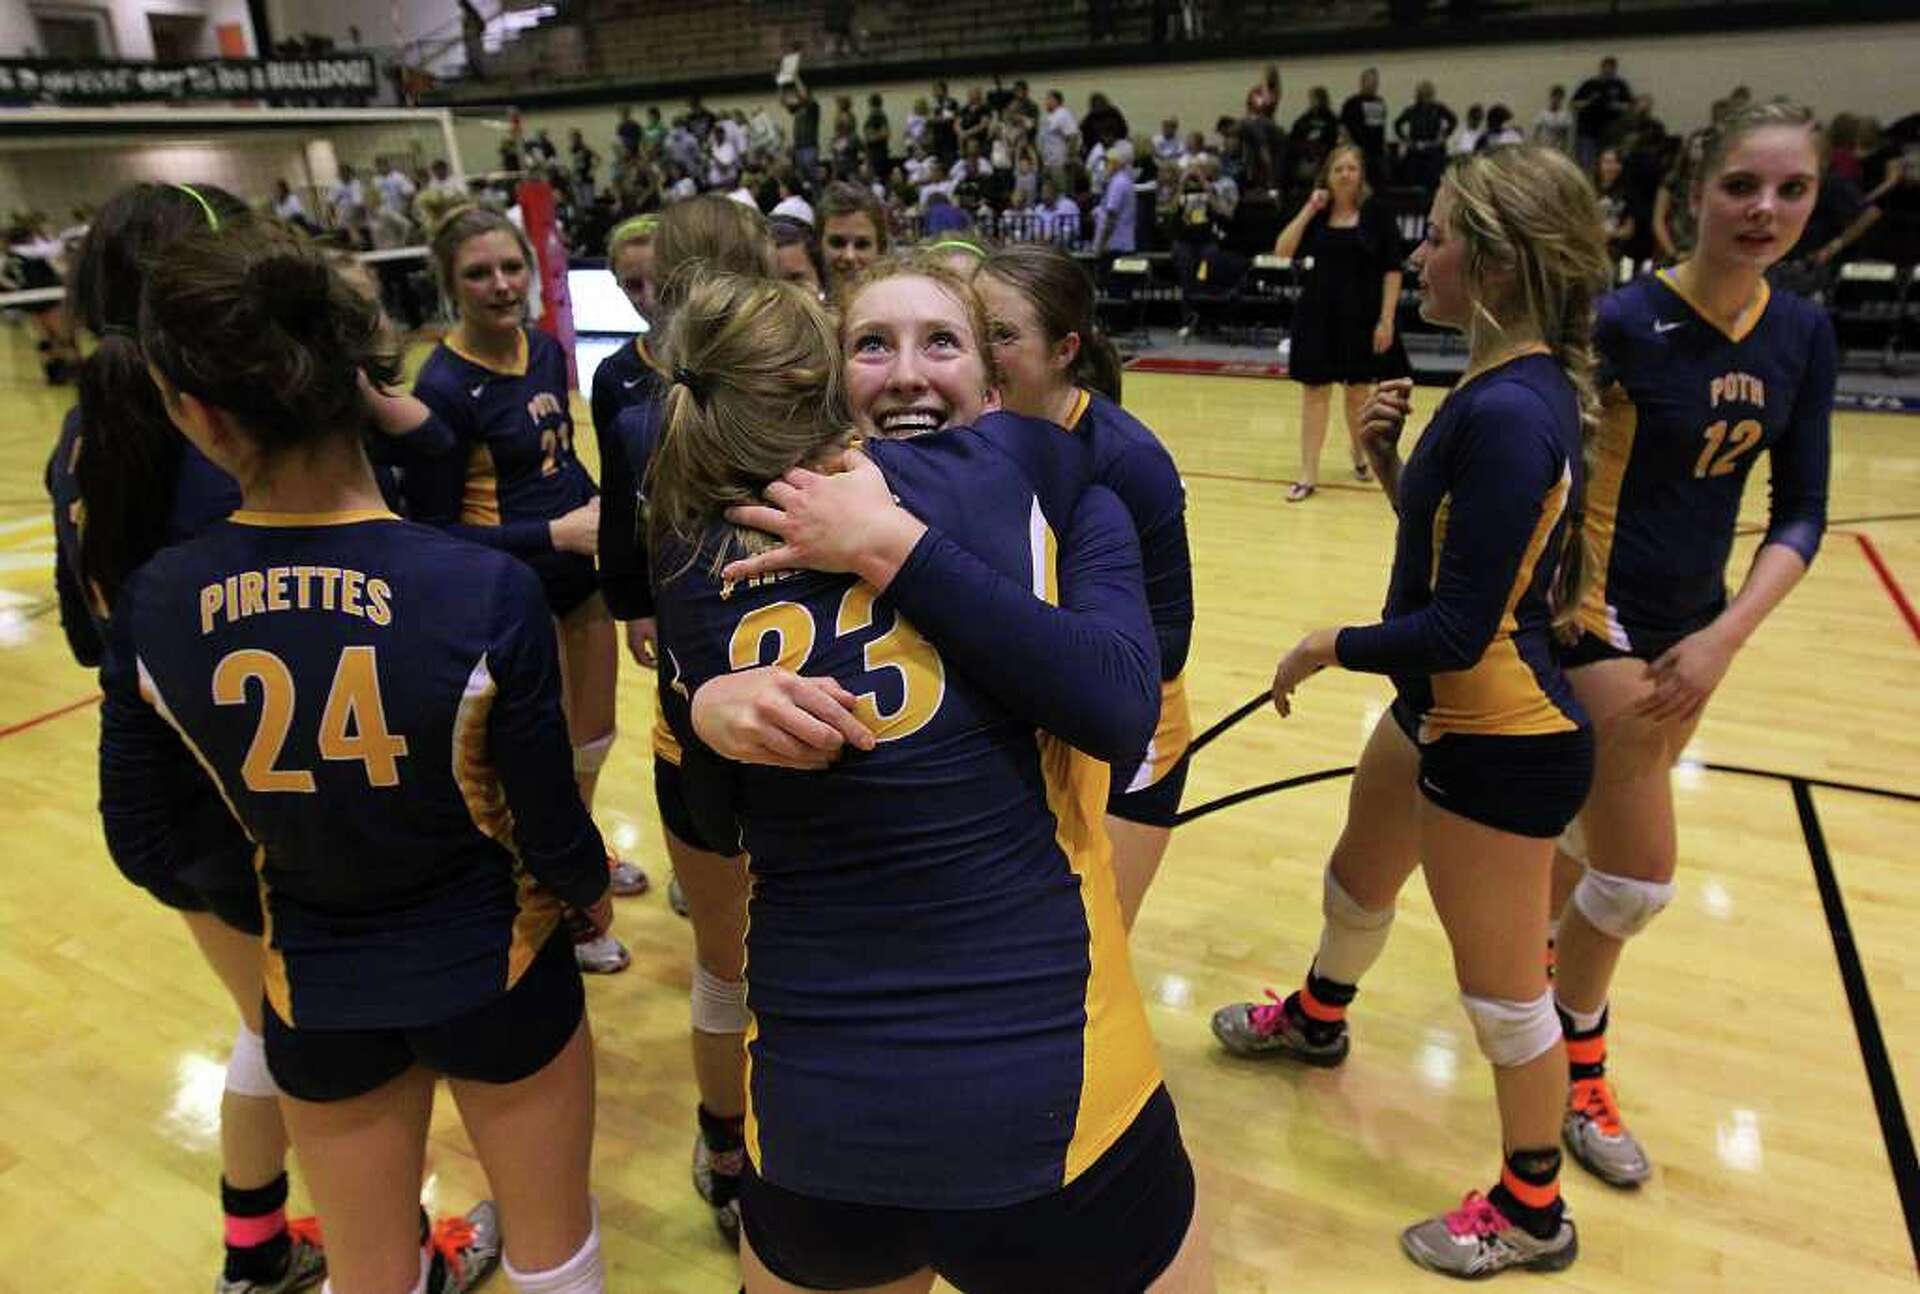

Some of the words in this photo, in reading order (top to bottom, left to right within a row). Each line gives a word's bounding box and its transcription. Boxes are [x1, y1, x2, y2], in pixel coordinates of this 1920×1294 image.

[1709, 372, 1765, 409] POTH
[1694, 419, 1763, 479] 12
[200, 565, 392, 634] PIRETTES
[212, 645, 409, 793] 24
